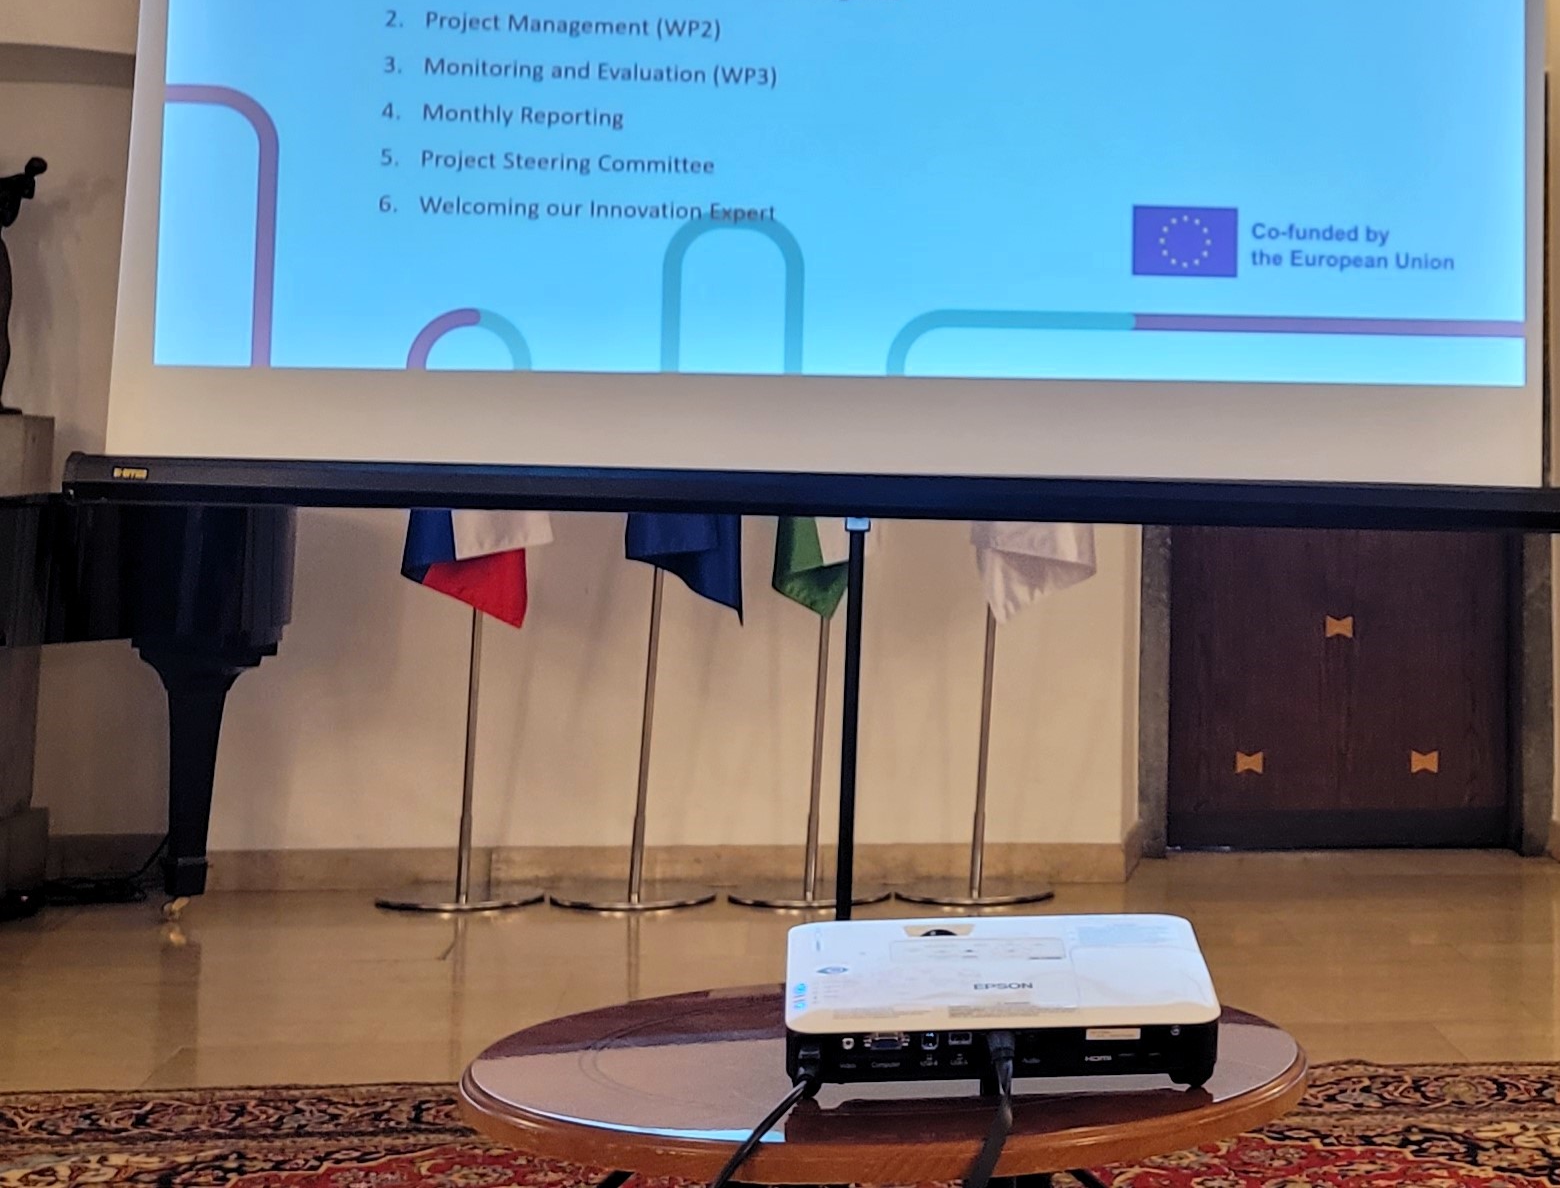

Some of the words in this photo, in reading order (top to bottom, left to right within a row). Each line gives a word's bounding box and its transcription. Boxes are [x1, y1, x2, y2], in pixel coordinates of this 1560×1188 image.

[386, 10, 404, 29] 2.
[426, 11, 500, 35] Project
[508, 14, 649, 39] Management
[656, 17, 721, 42] (WP2)
[384, 56, 402, 75] 3.
[424, 57, 544, 83] Monitoring
[550, 61, 590, 80] and
[597, 62, 706, 84] Evaluation
[713, 66, 777, 89] (WP3)
[382, 103, 401, 121] 4.
[422, 104, 513, 128] Monthly
[520, 107, 624, 130] Reporting
[380, 149, 399, 167] 5.
[421, 150, 496, 173] Project
[503, 152, 590, 175] Steering
[598, 154, 714, 175] Committee
[379, 195, 398, 214] 6.
[420, 196, 539, 221] Welcoming
[546, 201, 581, 218] our
[589, 200, 702, 221] Innovation
[710, 204, 776, 225] Expert
[1251, 222, 1359, 242] Co-funded
[1365, 226, 1390, 247] by
[1251, 250, 1283, 266] the
[1290, 251, 1388, 272] European
[1395, 253, 1455, 271] Union
[973, 982, 1033, 991] EPSON
